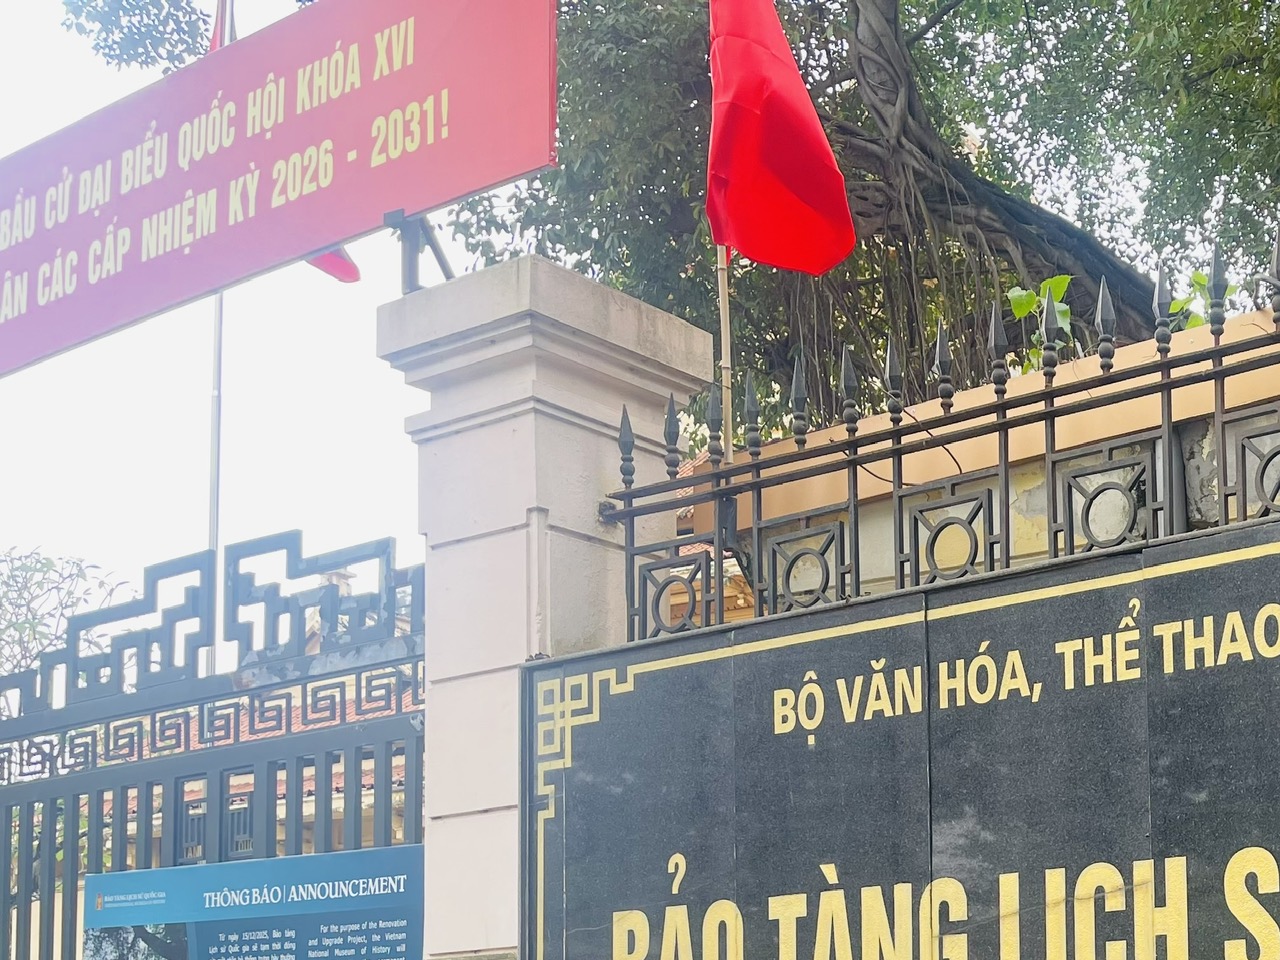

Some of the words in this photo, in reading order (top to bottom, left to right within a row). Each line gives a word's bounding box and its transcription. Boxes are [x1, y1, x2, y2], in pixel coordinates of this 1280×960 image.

[44, 166, 73, 230] CỬ
[78, 159, 112, 217] ĐẠI
[120, 120, 168, 195] BIỂU
[178, 90, 236, 172] QUỐC
[247, 72, 285, 139] HỘI
[296, 39, 361, 114] KHÓA
[373, 16, 415, 81] XVI
[37, 247, 78, 306] CÁC
[88, 215, 131, 285] CẤP
[141, 188, 217, 262] NHIỆM
[228, 162, 260, 226] KỲ
[271, 139, 334, 208] 2026
[347, 149, 357, 162] -
[773, 671, 825, 745] BỘ
[836, 657, 923, 724] VĂN
[938, 640, 1042, 709] HÓA,
[1054, 597, 1141, 690] THỂ
[203, 887, 250, 908] THÔNG
[251, 883, 282, 905] BÁO
[287, 874, 407, 902] ANNOUNCEMENT
